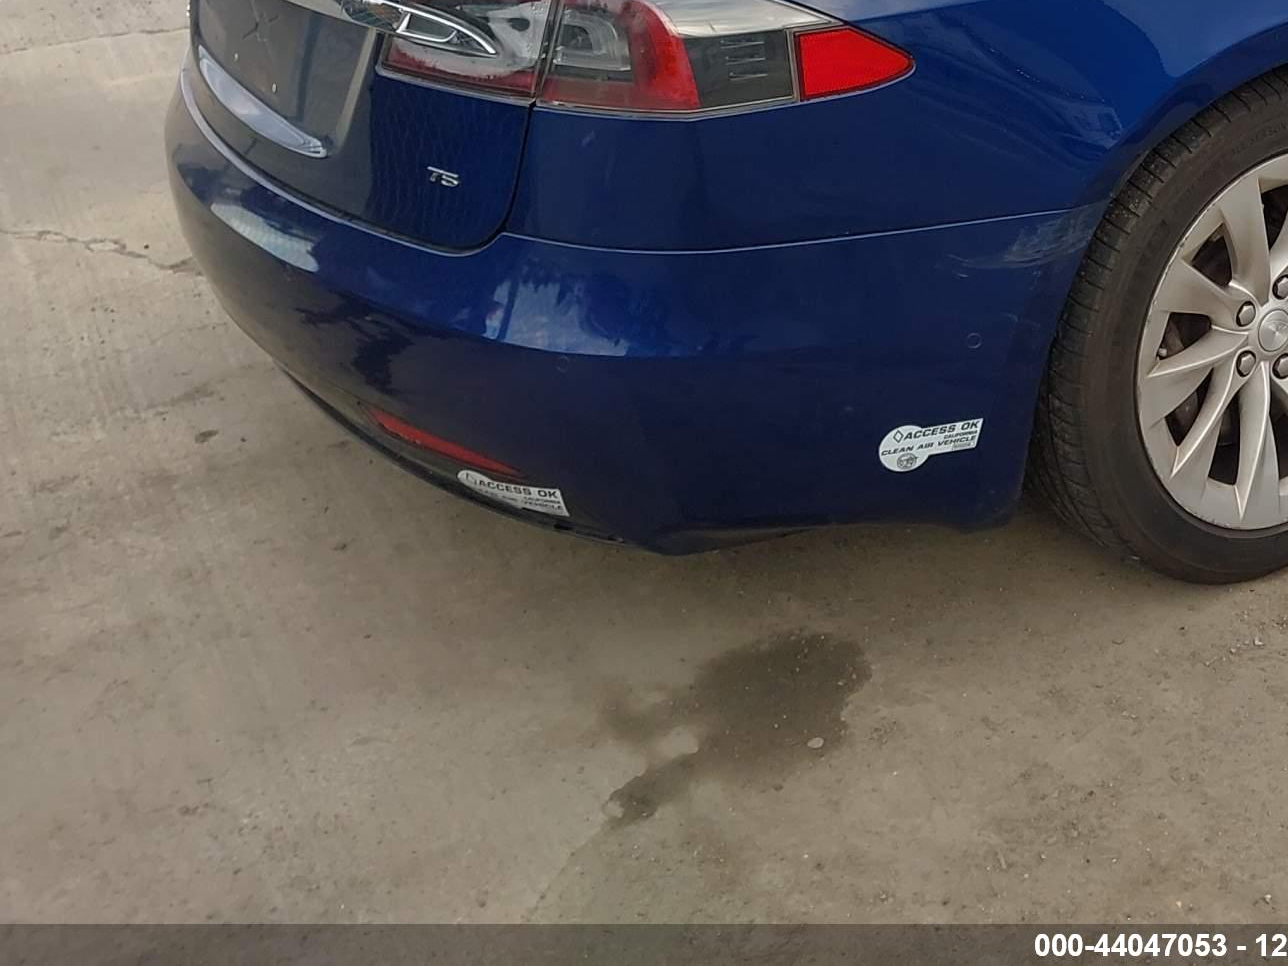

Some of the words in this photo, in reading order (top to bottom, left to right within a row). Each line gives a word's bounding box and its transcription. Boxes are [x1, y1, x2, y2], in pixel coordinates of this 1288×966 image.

[904, 425, 956, 441] ACCESS
[961, 420, 980, 431] OK
[881, 446, 914, 456] CLEAN
[917, 442, 934, 450] AIR
[938, 435, 976, 446] VEHICLE
[537, 489, 558, 499] OK
